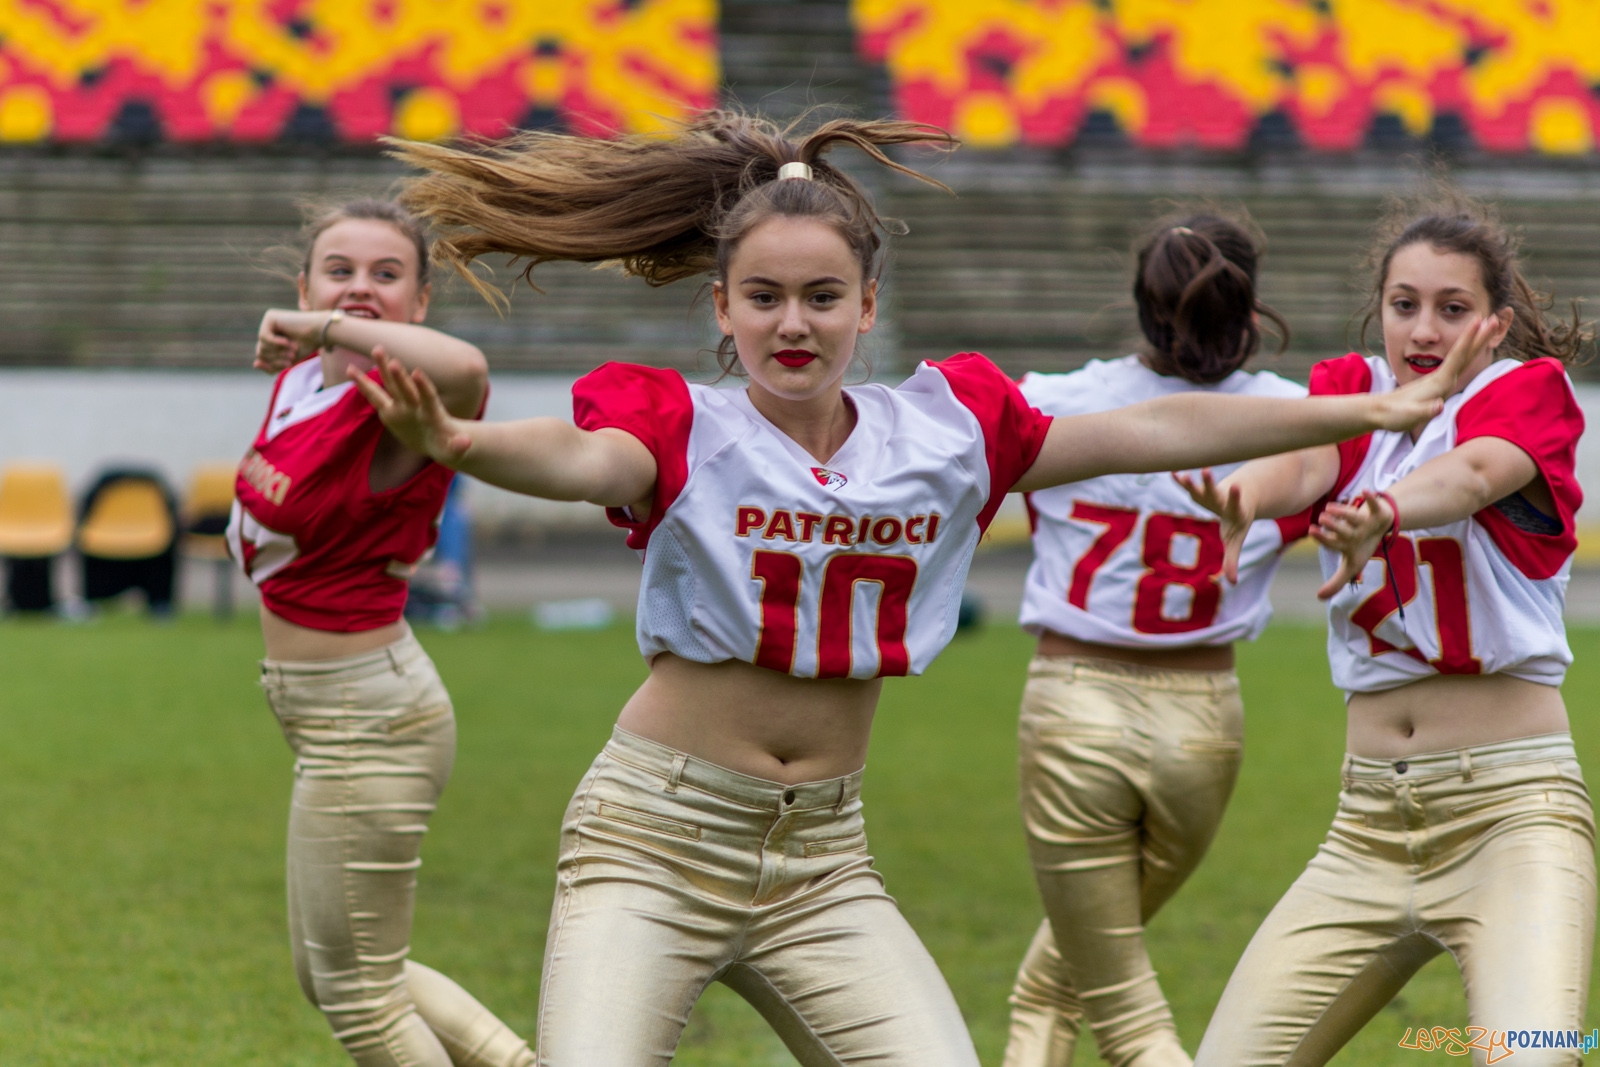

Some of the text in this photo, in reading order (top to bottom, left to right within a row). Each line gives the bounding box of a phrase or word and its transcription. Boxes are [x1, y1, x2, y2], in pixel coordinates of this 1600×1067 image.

[735, 505, 941, 546] PATRIOCI
[1067, 500, 1225, 634] 78
[751, 548, 918, 679] 10
[1350, 533, 1483, 676] 21
